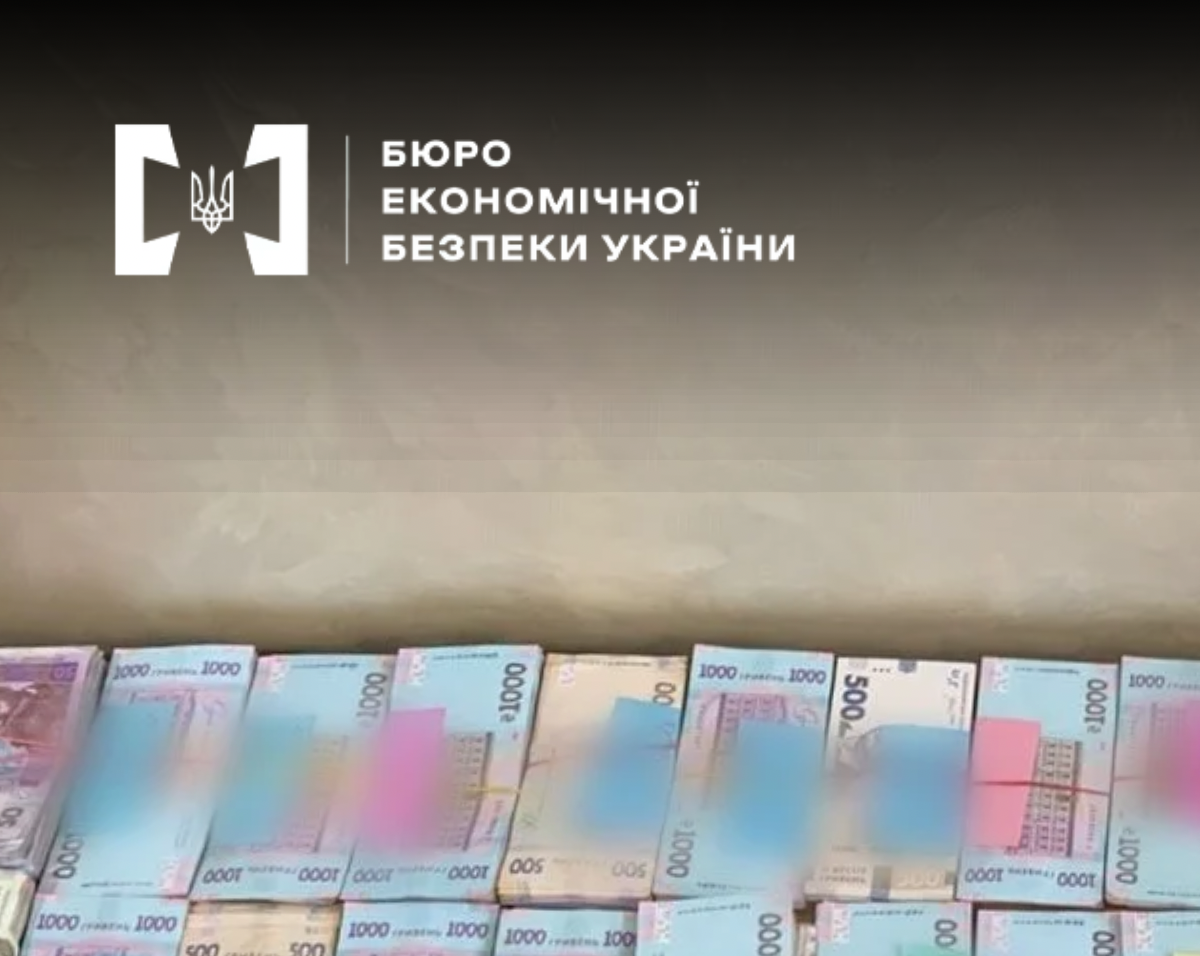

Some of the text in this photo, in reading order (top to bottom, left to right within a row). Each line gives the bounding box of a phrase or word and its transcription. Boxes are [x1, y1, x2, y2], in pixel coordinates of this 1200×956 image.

[114, 664, 150, 680] 1000
[201, 661, 241, 677] 1000
[700, 664, 737, 680] 1000
[788, 667, 827, 684] 1000
[1128, 673, 1166, 689] 1000
[653, 682, 677, 708] 00
[841, 673, 868, 722] 500
[202, 866, 244, 884] 1000
[298, 866, 340, 883] 1000
[448, 863, 489, 881] 1000
[510, 857, 544, 875] 500
[965, 867, 1004, 884] 1000
[1056, 871, 1097, 888] 1000
[36, 914, 81, 932] 1000
[135, 915, 177, 932] 1000
[348, 922, 391, 938] 1000
[445, 922, 489, 939] 1000
[504, 928, 547, 945] 1000
[603, 930, 637, 948] 100
